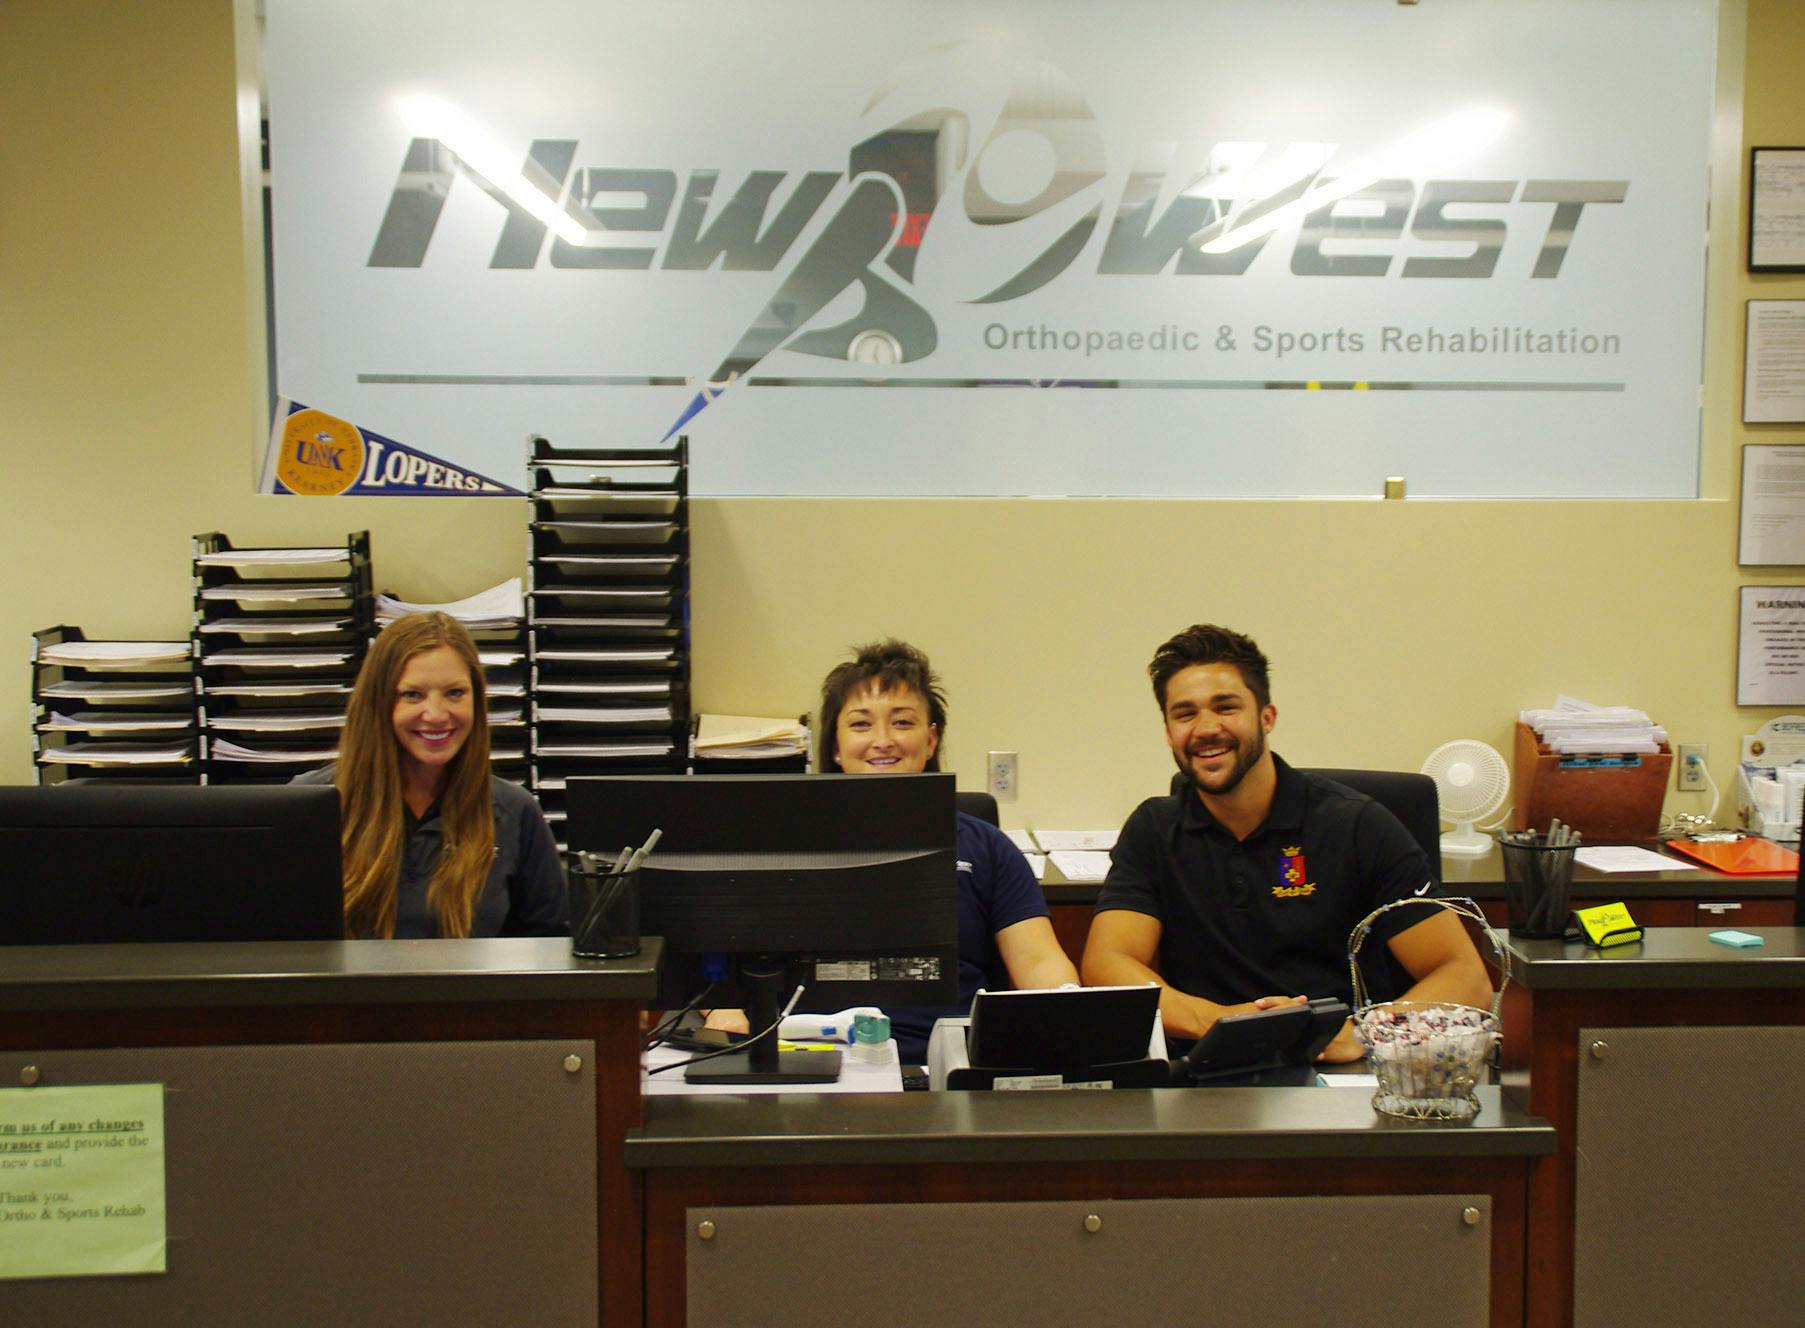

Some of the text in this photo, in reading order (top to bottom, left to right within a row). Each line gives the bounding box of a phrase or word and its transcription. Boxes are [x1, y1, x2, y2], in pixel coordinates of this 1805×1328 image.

[367, 137, 844, 271] New
[1097, 141, 1630, 279] West
[983, 322, 1622, 357] Orthopaedic & Sports Rehabilitation
[296, 440, 346, 471] UNK
[361, 440, 482, 491] LOPERS
[22, 1122, 37, 1133] us
[41, 1120, 56, 1132] of
[59, 1121, 83, 1133] any
[88, 1118, 144, 1132] changes
[46, 1137, 71, 1149] and
[74, 1135, 124, 1151] provide
[128, 1135, 149, 1147] the
[1, 1159, 28, 1169] new
[0, 1204, 147, 1222] Ortho & Sports Rehab
